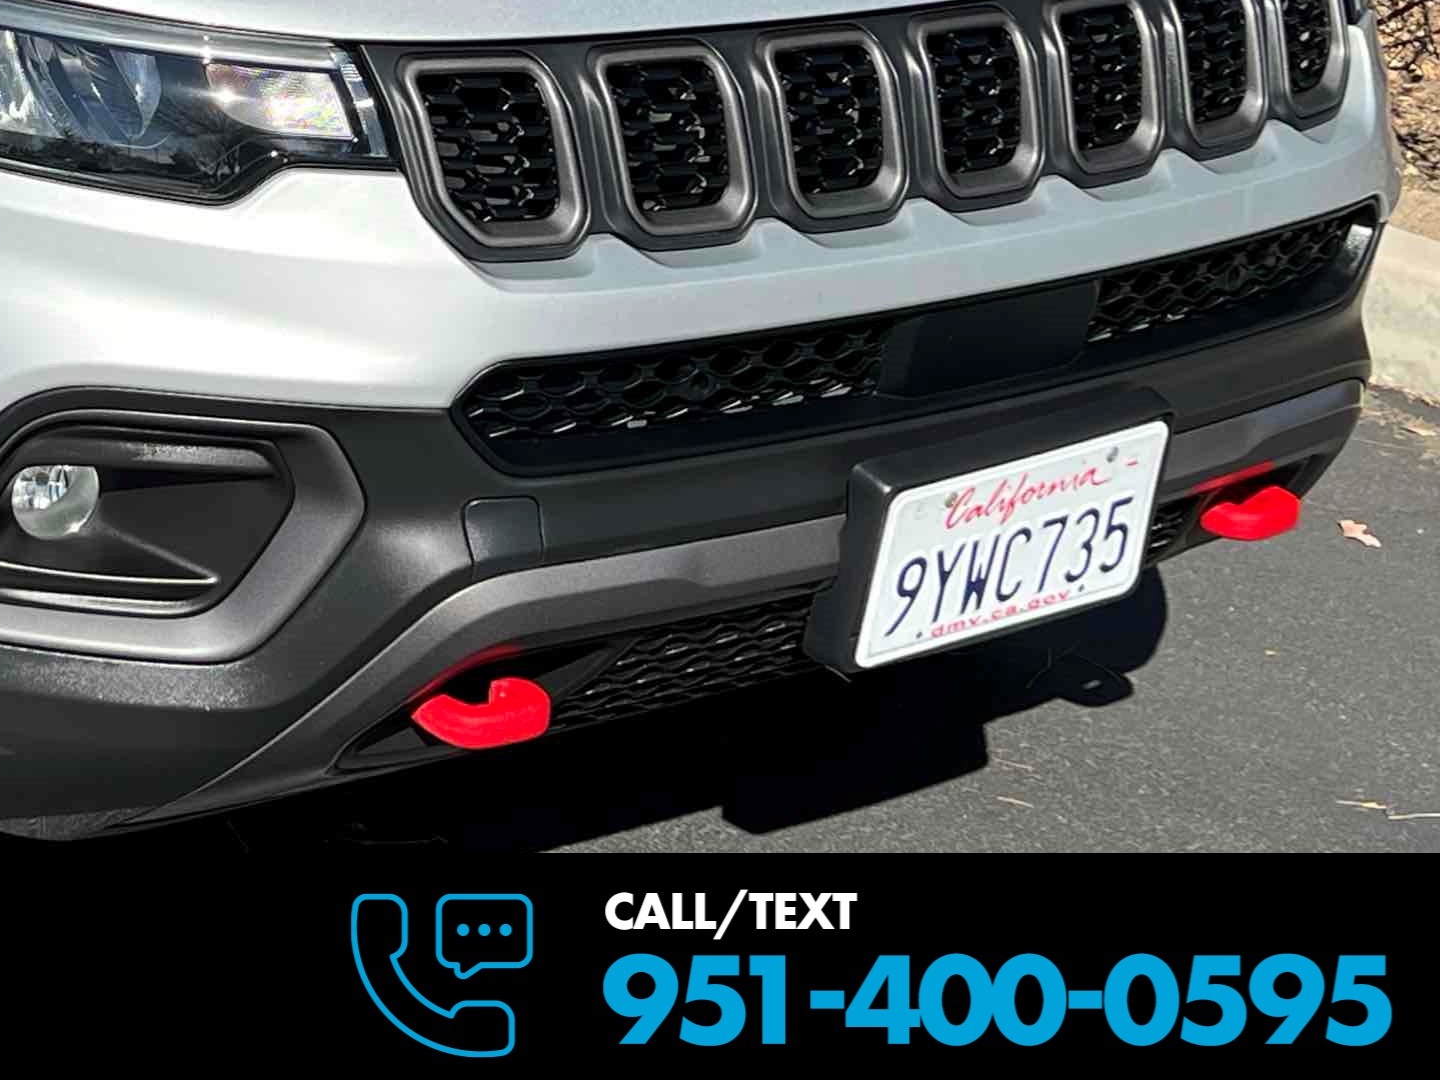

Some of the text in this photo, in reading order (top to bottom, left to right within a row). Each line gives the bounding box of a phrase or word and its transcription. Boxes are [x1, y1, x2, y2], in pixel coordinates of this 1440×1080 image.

[946, 467, 1108, 530] California
[884, 496, 1134, 637] 9YWC735
[930, 589, 1071, 639] dmv.ca.gov
